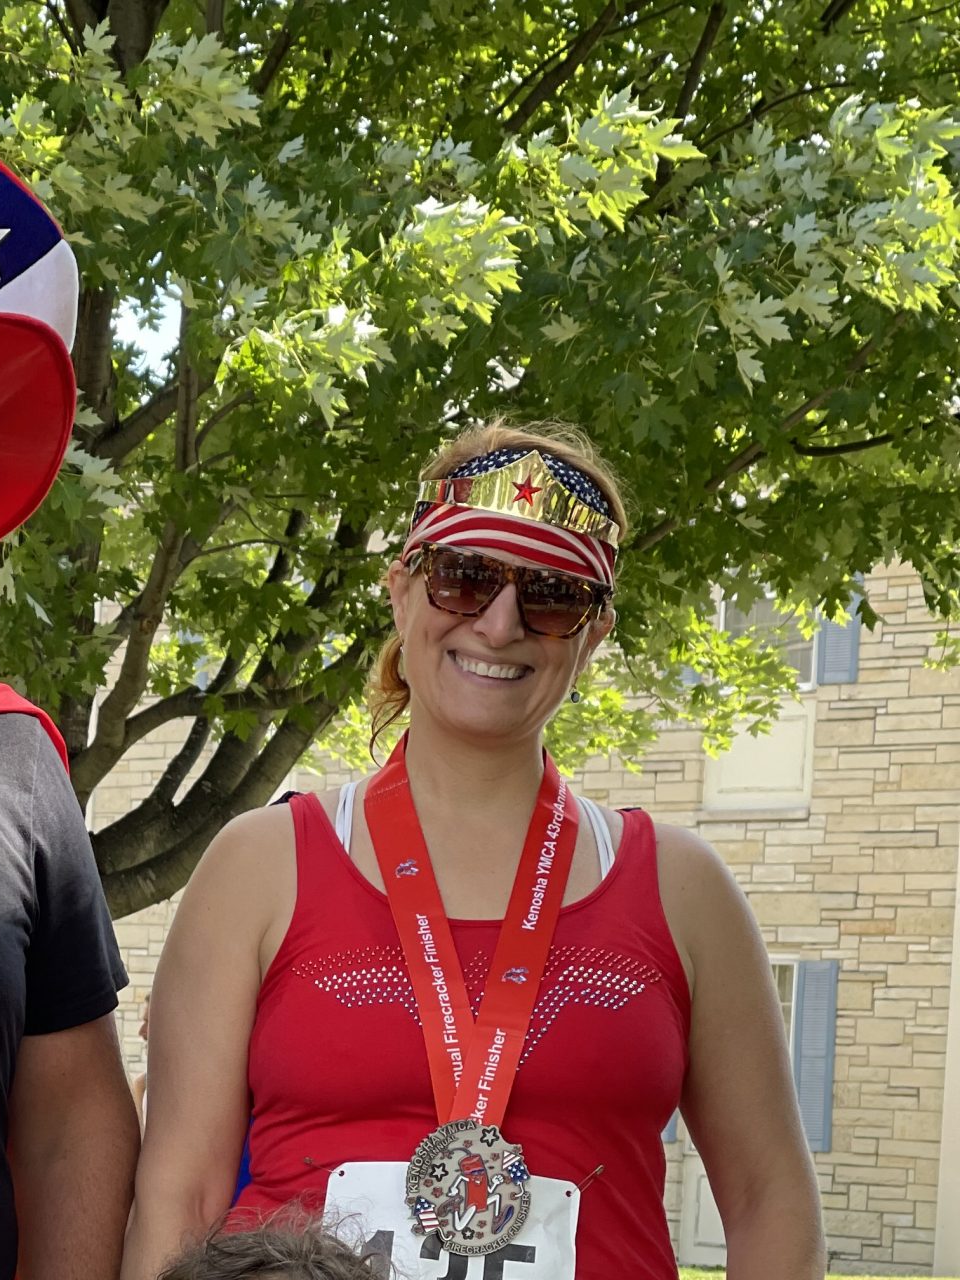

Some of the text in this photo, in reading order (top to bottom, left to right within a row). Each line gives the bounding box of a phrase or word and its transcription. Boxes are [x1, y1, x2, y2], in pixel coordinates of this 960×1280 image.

[521, 877, 548, 931] Kenosha
[535, 841, 557, 876] YMCA
[546, 810, 565, 839] 43rd
[415, 913, 439, 963] Finisher
[431, 964, 460, 1044] Firecracker
[478, 1027, 507, 1091] Finisher
[408, 1120, 477, 1194] KENOSHA YMCA
[428, 1135, 458, 1160] ANNUAL
[443, 1191, 532, 1253] FIRECRACKER FINISHER
